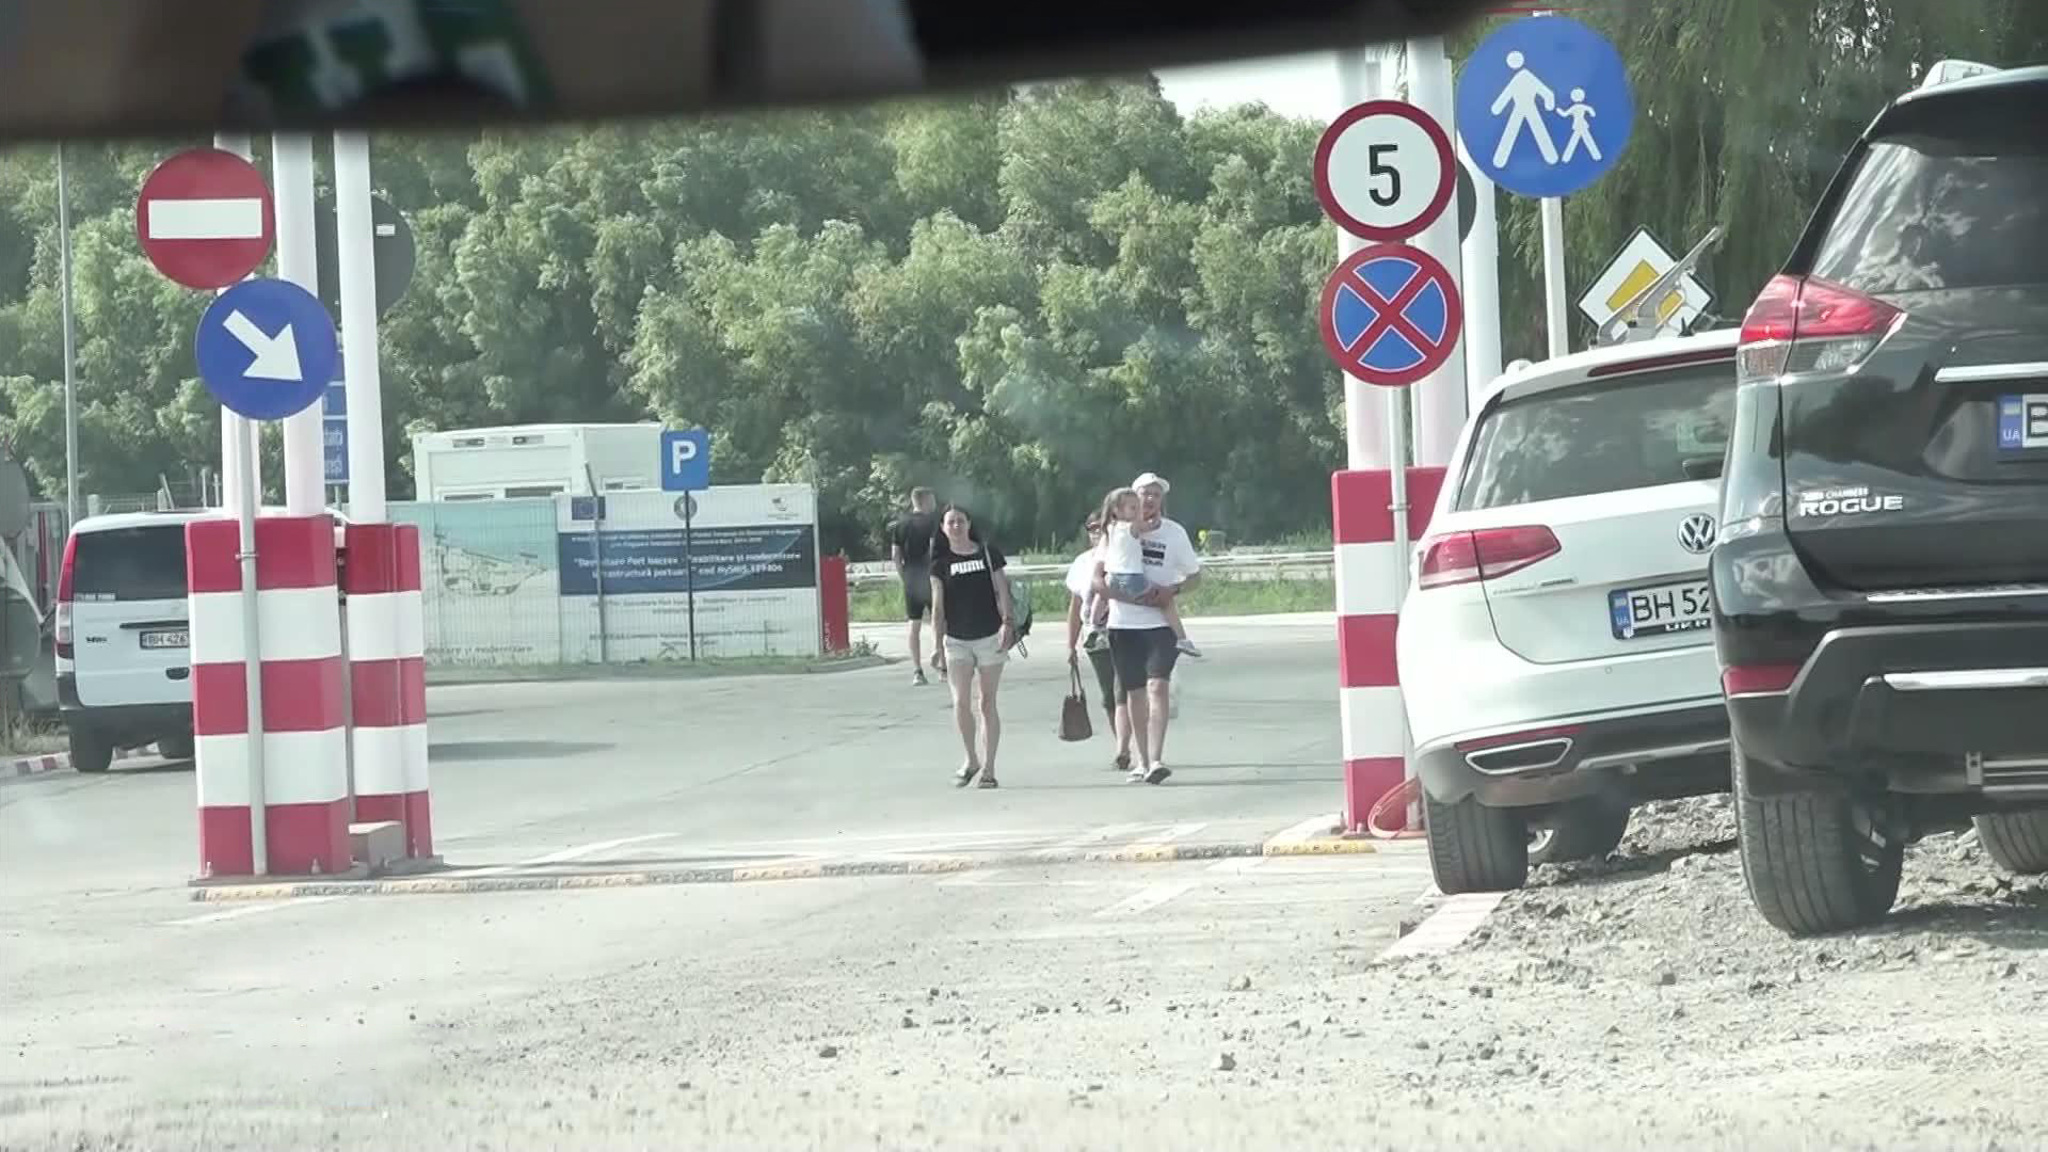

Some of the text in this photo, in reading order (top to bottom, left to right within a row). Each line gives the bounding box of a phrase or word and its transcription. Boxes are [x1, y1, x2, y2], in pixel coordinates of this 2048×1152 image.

[1368, 143, 1401, 207] 5
[2002, 428, 2020, 441] UA
[672, 441, 697, 475] P
[1799, 495, 1903, 517] ROGUE
[950, 559, 986, 576] PUMA
[1632, 585, 1710, 624] BH 52
